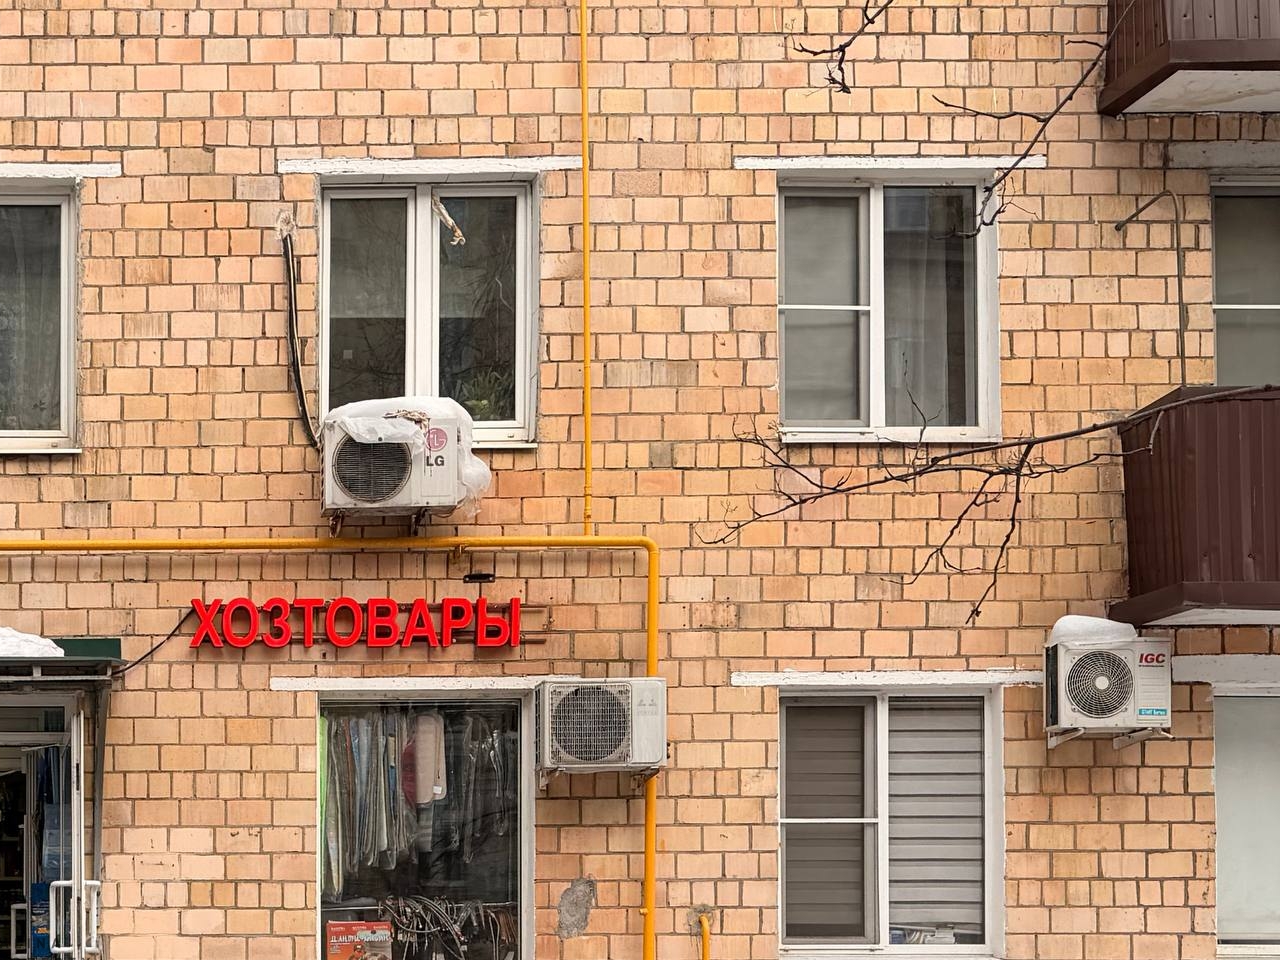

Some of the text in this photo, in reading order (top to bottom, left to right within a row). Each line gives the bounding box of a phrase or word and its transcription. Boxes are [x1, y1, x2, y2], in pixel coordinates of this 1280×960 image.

[426, 455, 445, 467] LG
[189, 597, 521, 648] ХОЗТОВАРЫ
[1138, 653, 1166, 664] IGC
